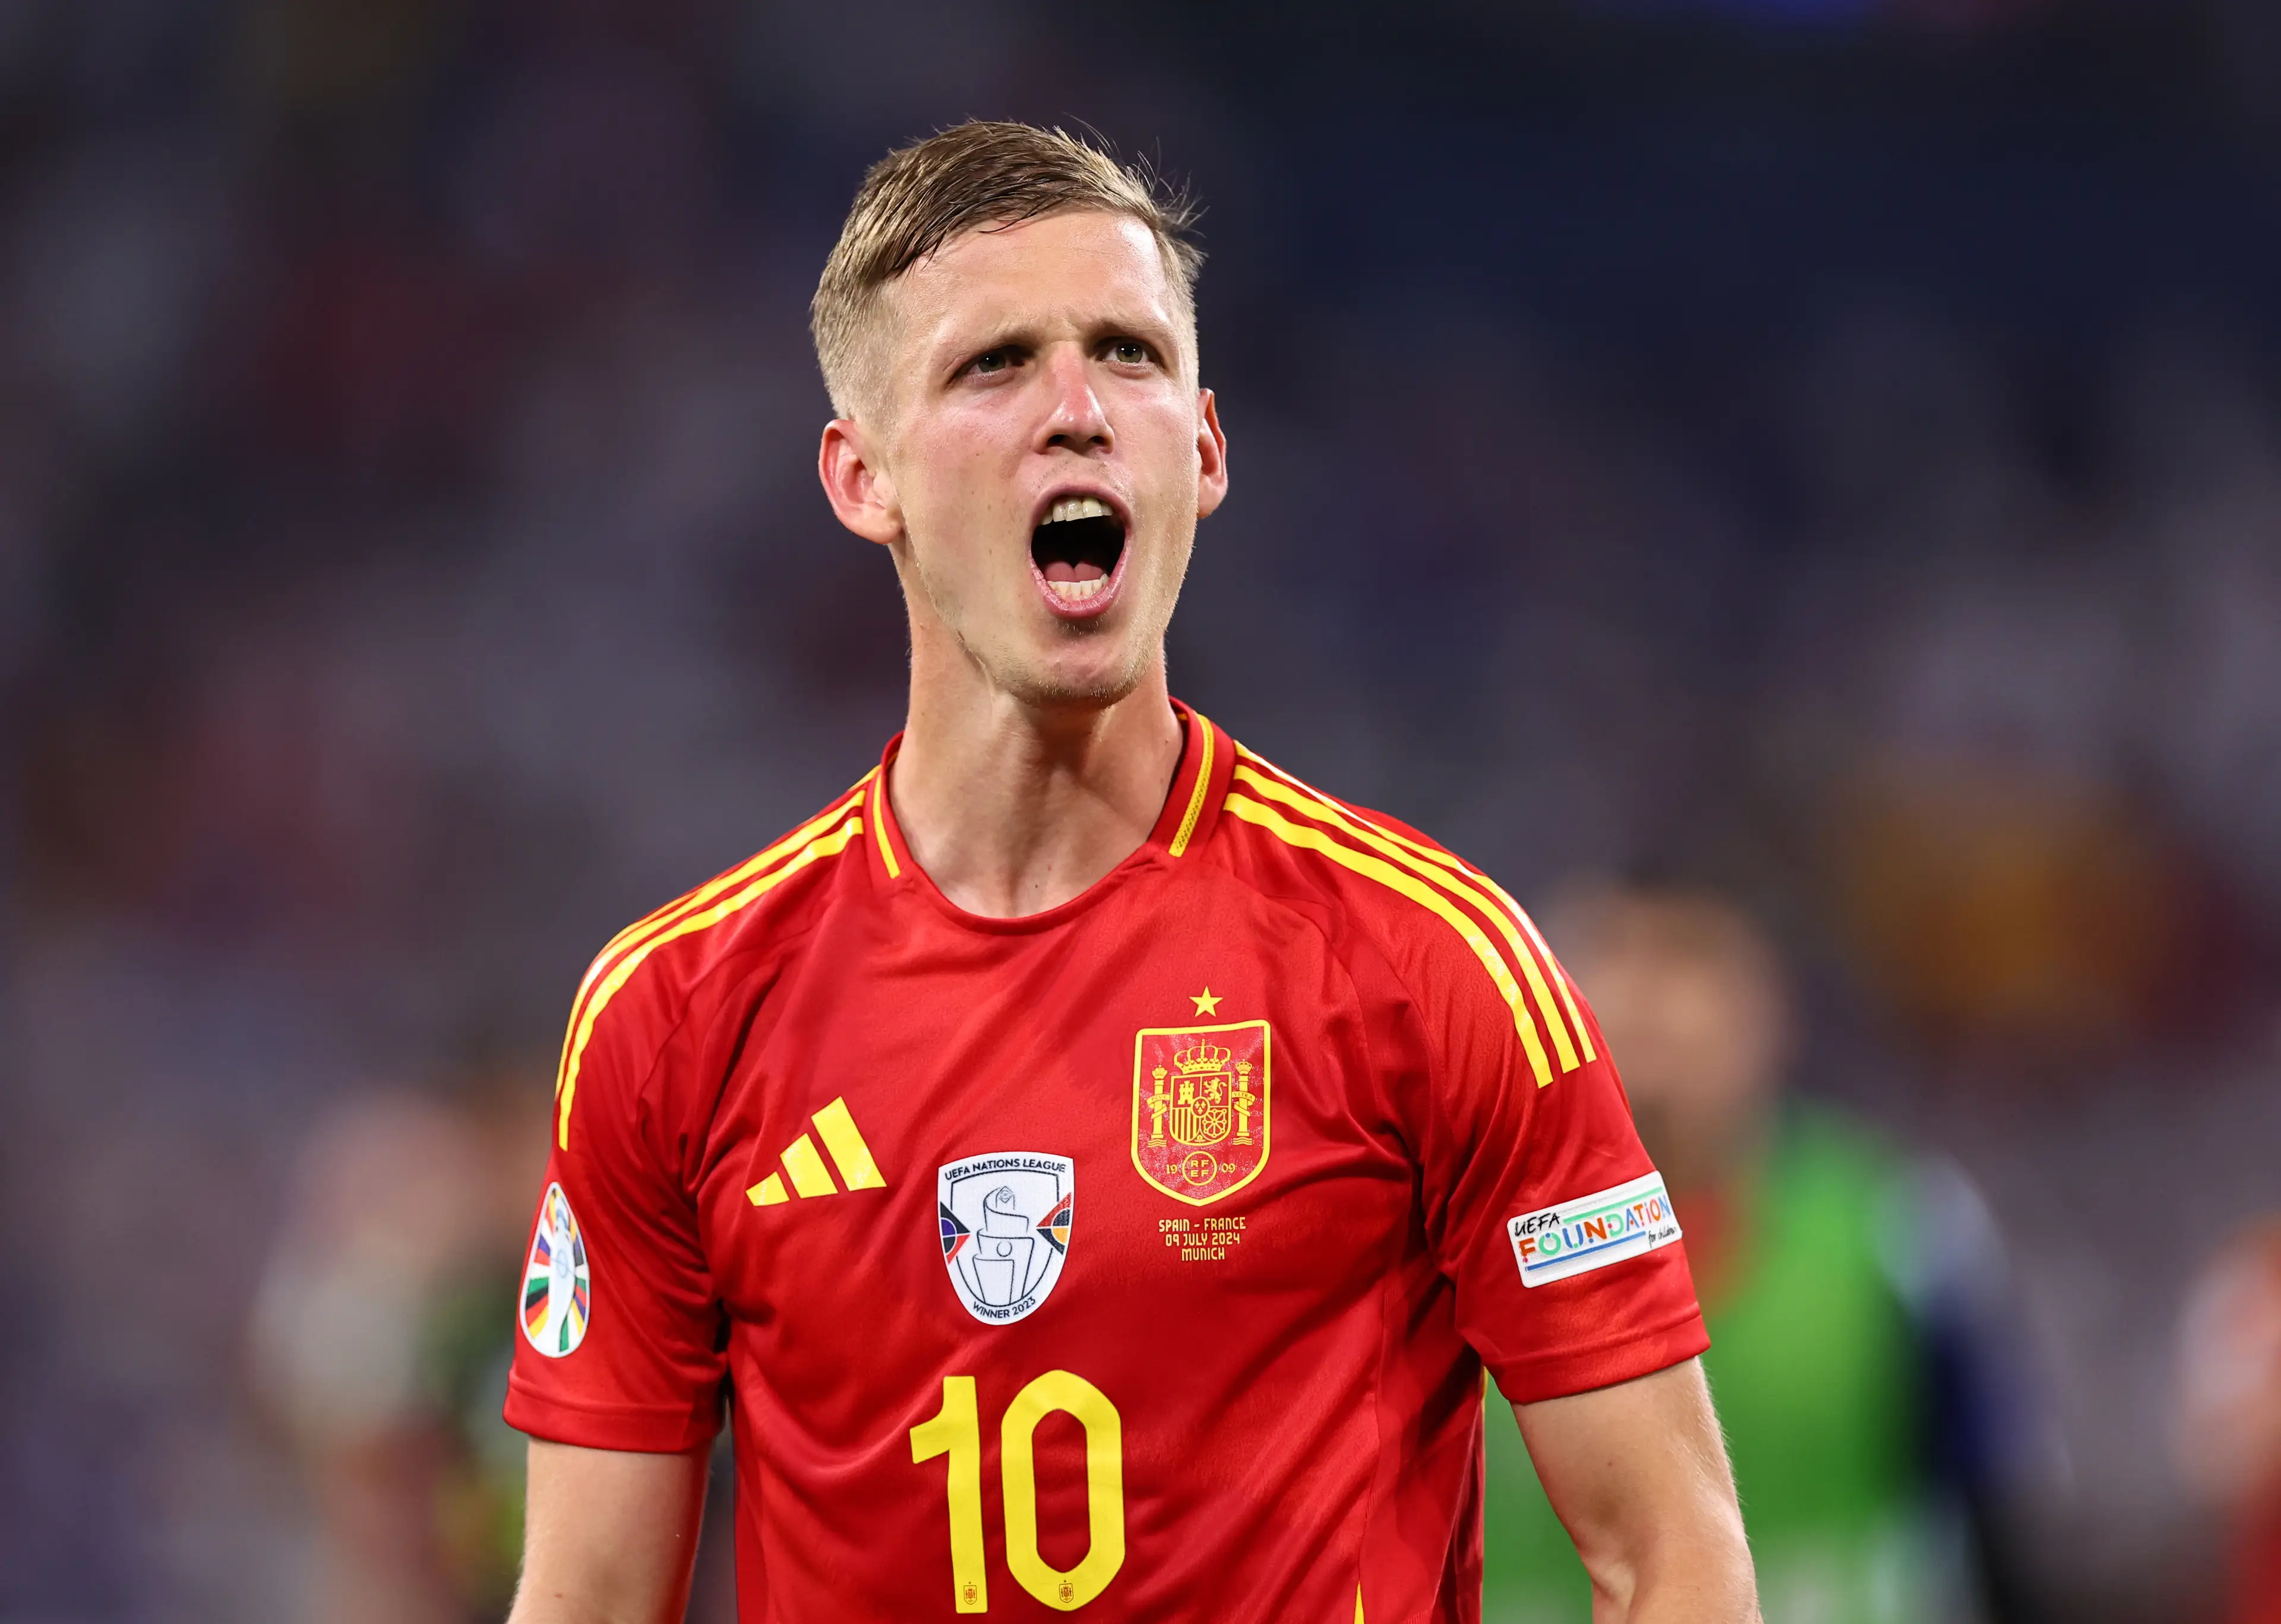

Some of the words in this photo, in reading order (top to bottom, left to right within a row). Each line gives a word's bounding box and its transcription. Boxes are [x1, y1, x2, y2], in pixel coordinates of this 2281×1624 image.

[945, 1166, 971, 1180] UEFA
[972, 1158, 1020, 1172] NATIONS
[1023, 1159, 1067, 1173] LEAGUE
[1166, 1164, 1179, 1174] 19
[1221, 1162, 1236, 1173] 09
[1158, 1218, 1190, 1233] SPAIN
[1204, 1217, 1246, 1231] FRANCE
[1514, 1212, 1560, 1237] UEFA
[1518, 1194, 1672, 1263] FOUNDATION
[1165, 1234, 1180, 1247] 09
[1183, 1233, 1208, 1246] JULY
[1212, 1232, 1240, 1245] 2024
[1181, 1247, 1225, 1261] MUNICH
[974, 1300, 1010, 1318] WINNER
[1012, 1296, 1036, 1316] 2023
[909, 1369, 1126, 1613] 10
